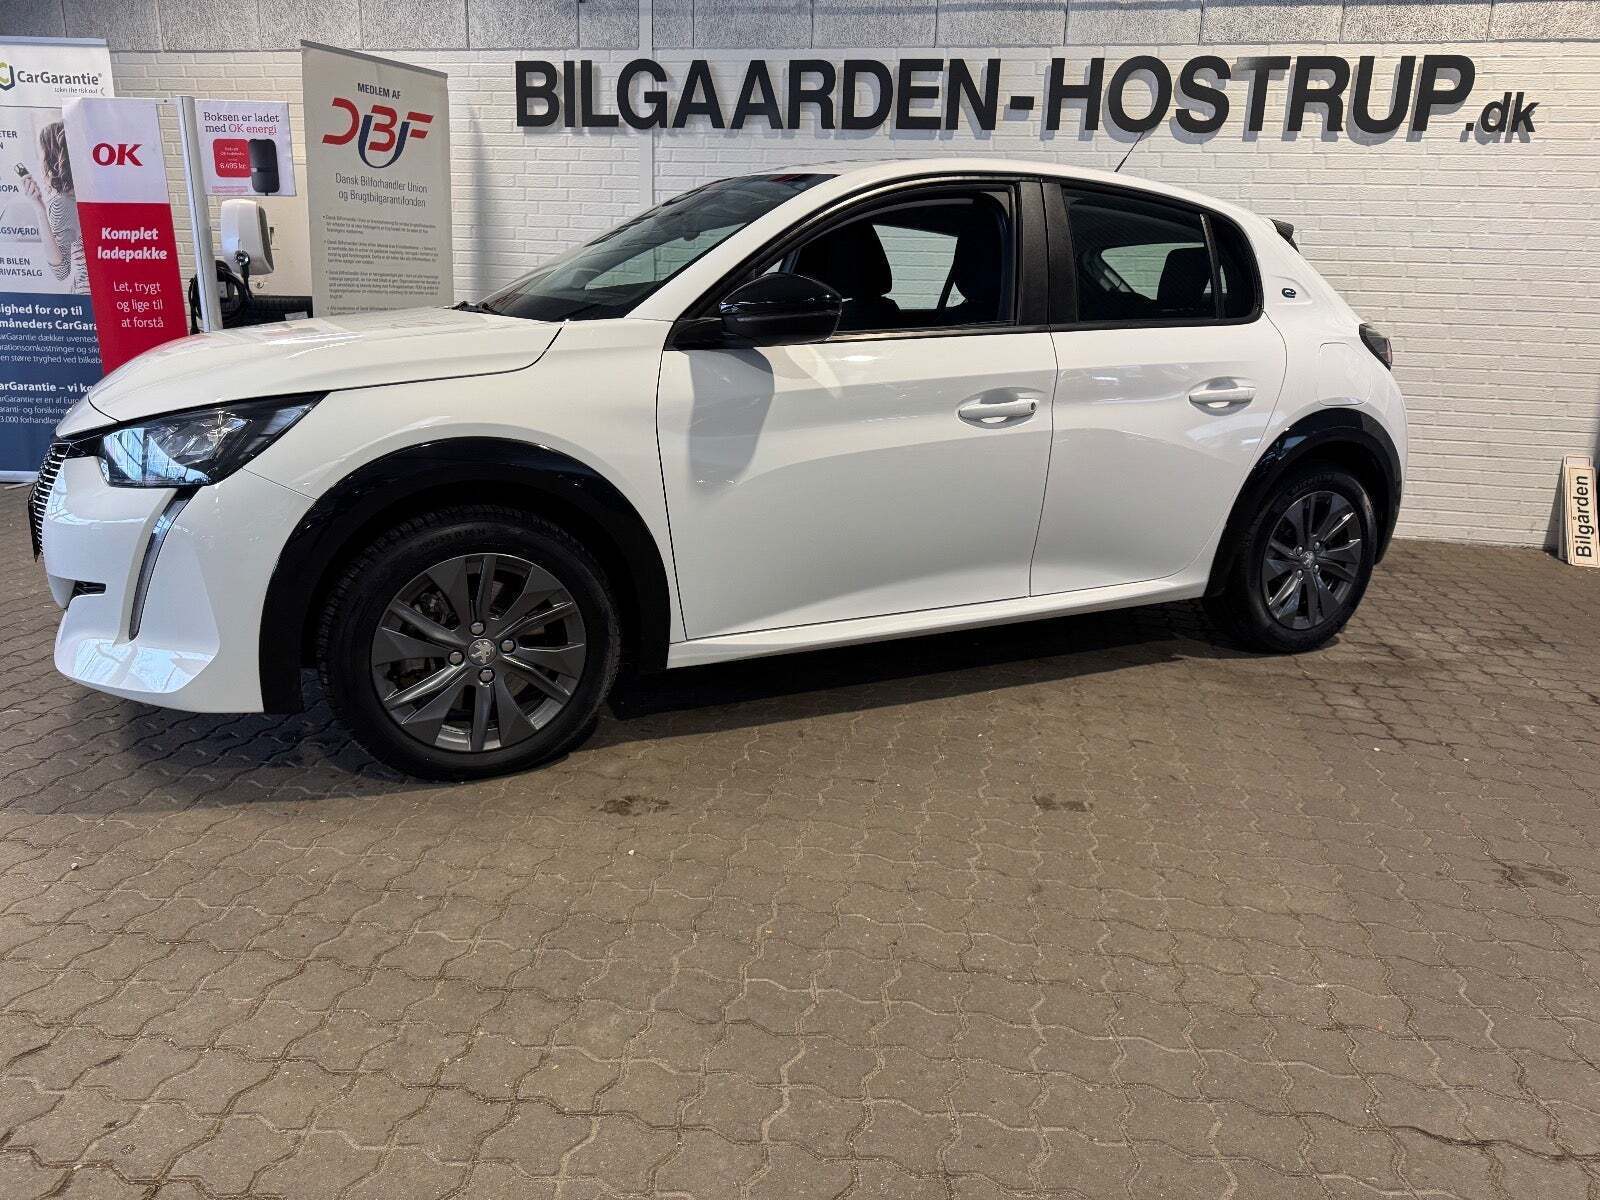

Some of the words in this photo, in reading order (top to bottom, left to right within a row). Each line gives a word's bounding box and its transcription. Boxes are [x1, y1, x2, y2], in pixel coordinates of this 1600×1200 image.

[357, 82, 390, 98] MEDLEM
[391, 89, 401, 99] AF
[204, 112, 239, 122] Boksen
[254, 113, 279, 122] ladet
[205, 124, 226, 133] med
[228, 124, 244, 133] OK
[246, 124, 277, 135] energi
[92, 143, 144, 167] OK
[335, 172, 359, 186] Dansk
[360, 175, 405, 191] Bilforhandler
[407, 181, 428, 193] Union
[0, 185, 19, 193] OPA
[338, 190, 348, 201] og
[0, 226, 39, 236] GSVÆRDI
[101, 227, 159, 243] Komplet
[97, 246, 168, 262] ladepakke
[6, 257, 30, 266] BILEN
[113, 280, 132, 293] Let,
[134, 281, 161, 295] trygt
[34, 304, 51, 314] for
[53, 306, 68, 317] op
[70, 305, 83, 316] til
[116, 301, 130, 313] og
[131, 300, 150, 313] lige
[152, 300, 163, 310] til
[0, 318, 53, 330] måneders
[121, 318, 132, 328] at
[133, 316, 164, 328] forstå
[37, 333, 64, 341] dækker
[76, 346, 87, 354] og
[33, 355, 62, 364] tryghed
[67, 383, 77, 392] vi
[0, 395, 33, 403] rGarantie
[1573, 475, 1594, 558] Bilgården
